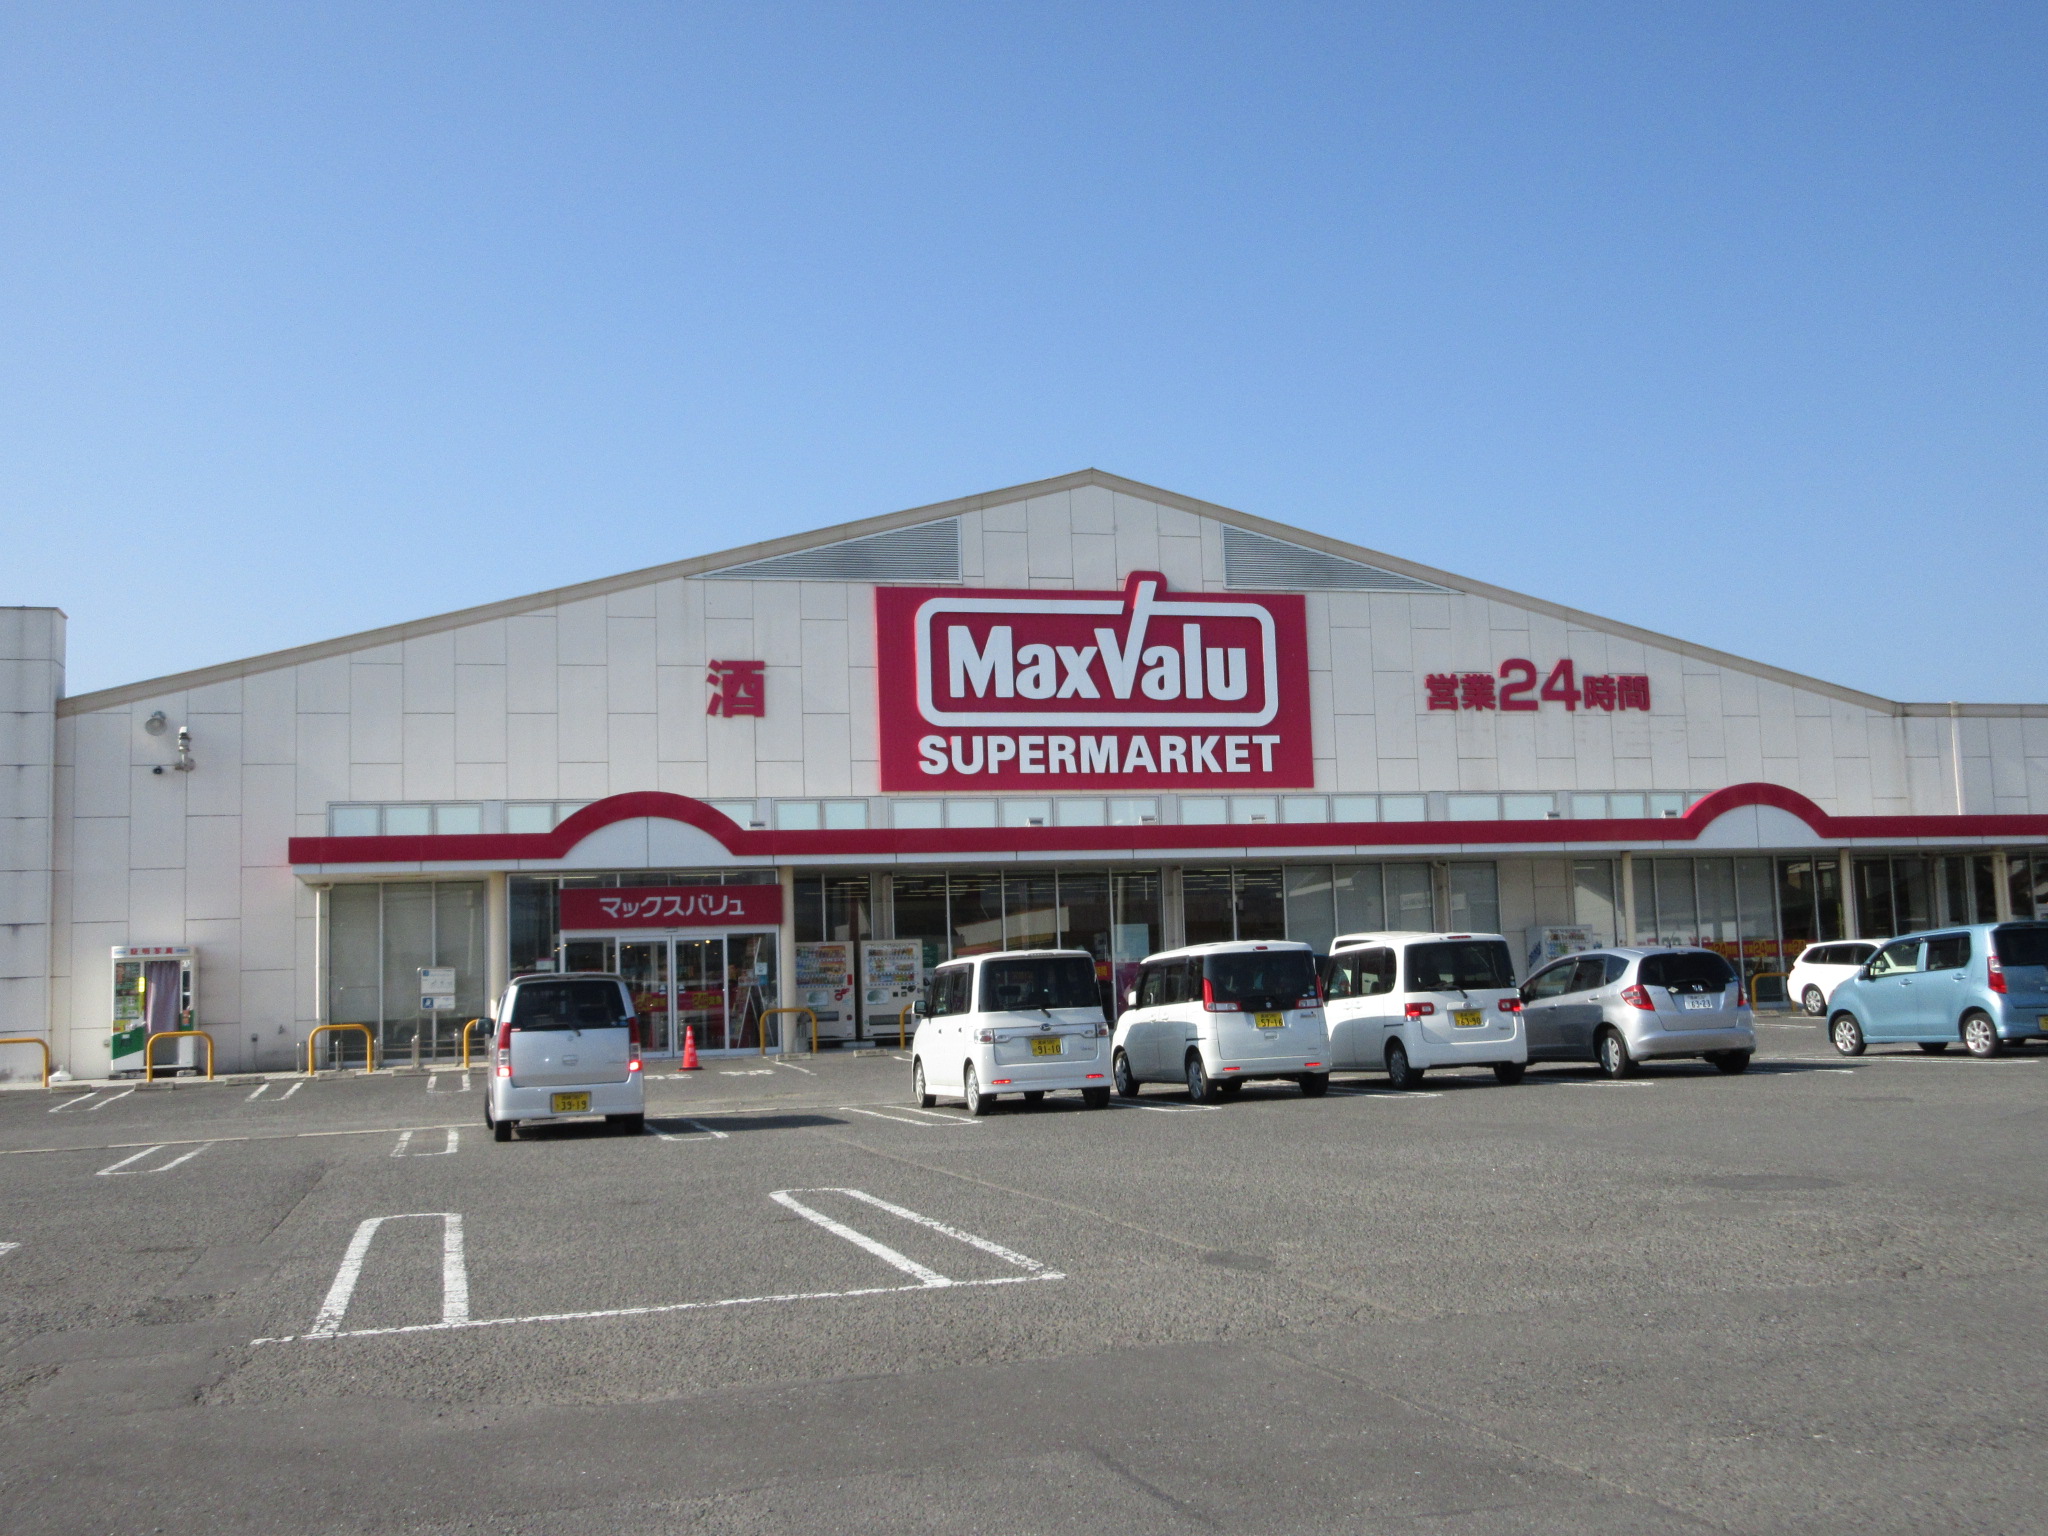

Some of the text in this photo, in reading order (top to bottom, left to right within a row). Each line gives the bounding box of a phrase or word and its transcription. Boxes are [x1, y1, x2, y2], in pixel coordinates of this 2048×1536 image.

[947, 580, 1248, 701] MaxValu
[707, 659, 765, 718] 酒
[1424, 658, 1650, 712] 営業24時間
[918, 734, 1281, 775] SUPERMARKET
[598, 894, 746, 919] マックスバリュ
